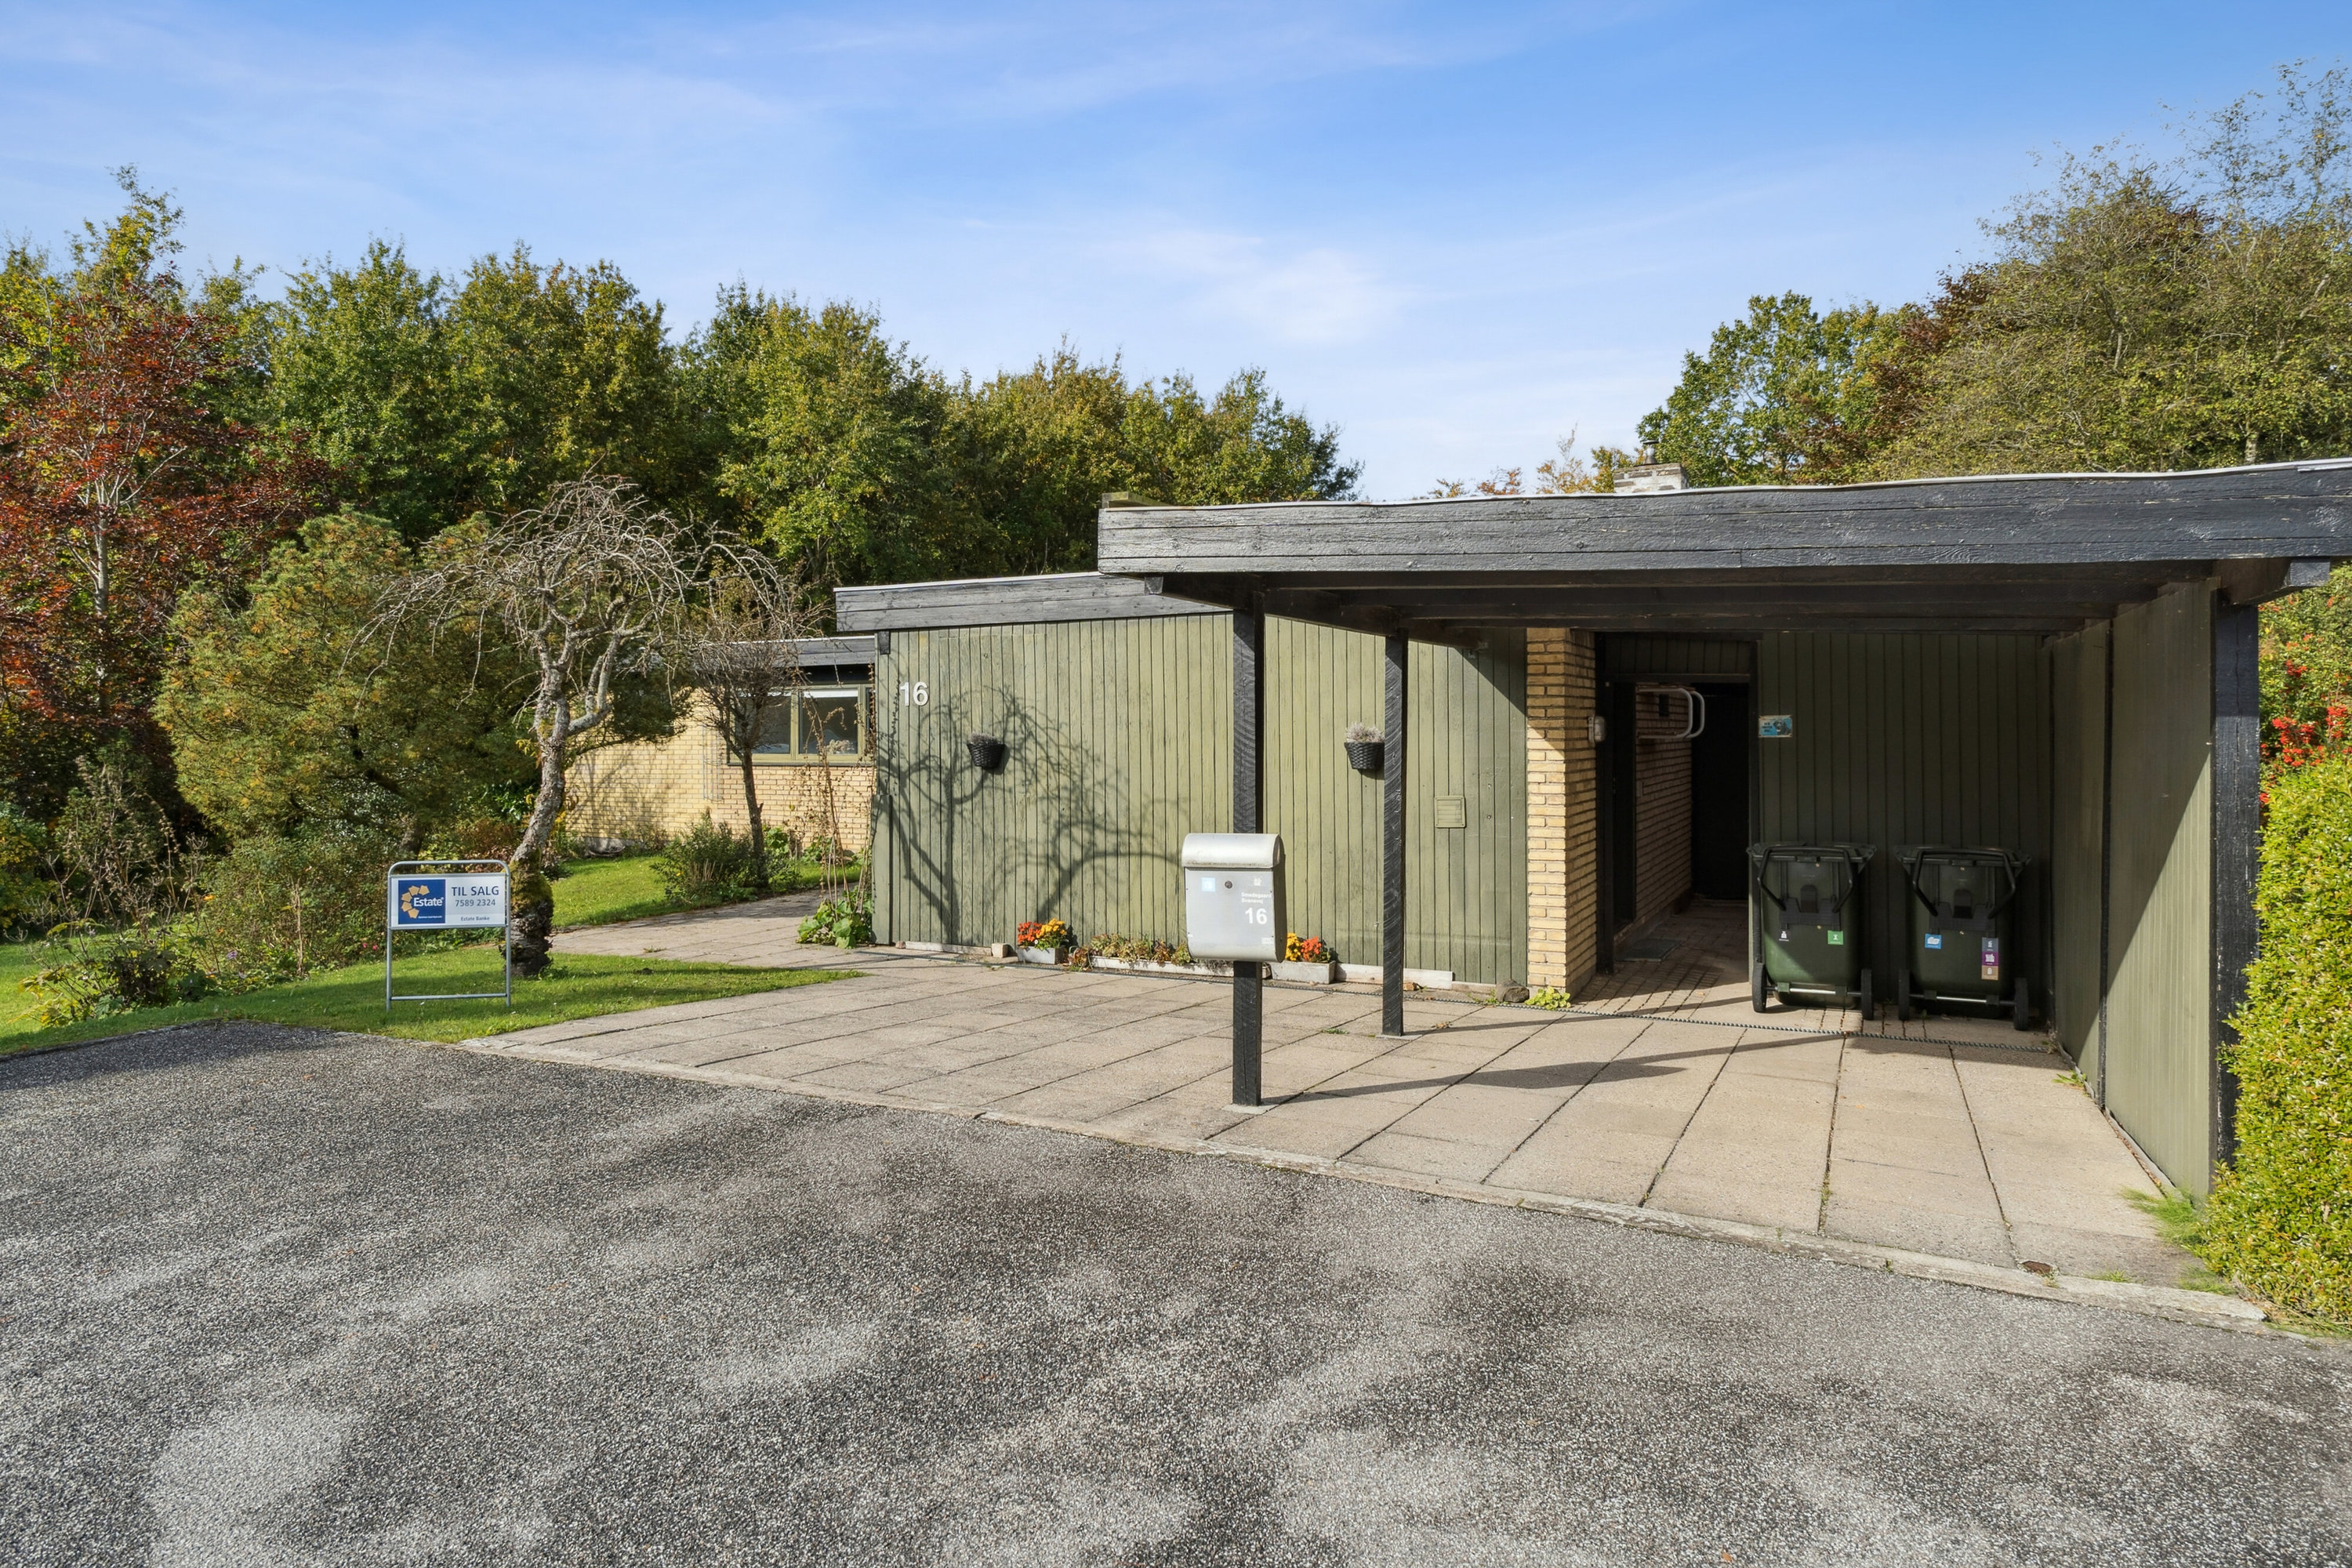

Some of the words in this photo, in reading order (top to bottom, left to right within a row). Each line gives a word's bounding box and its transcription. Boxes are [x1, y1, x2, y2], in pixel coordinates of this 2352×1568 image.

[900, 681, 928, 706] 16
[452, 887, 467, 896] TIL
[470, 886, 499, 896] SALG
[413, 897, 443, 907] Estate
[1245, 907, 1268, 925] 16
